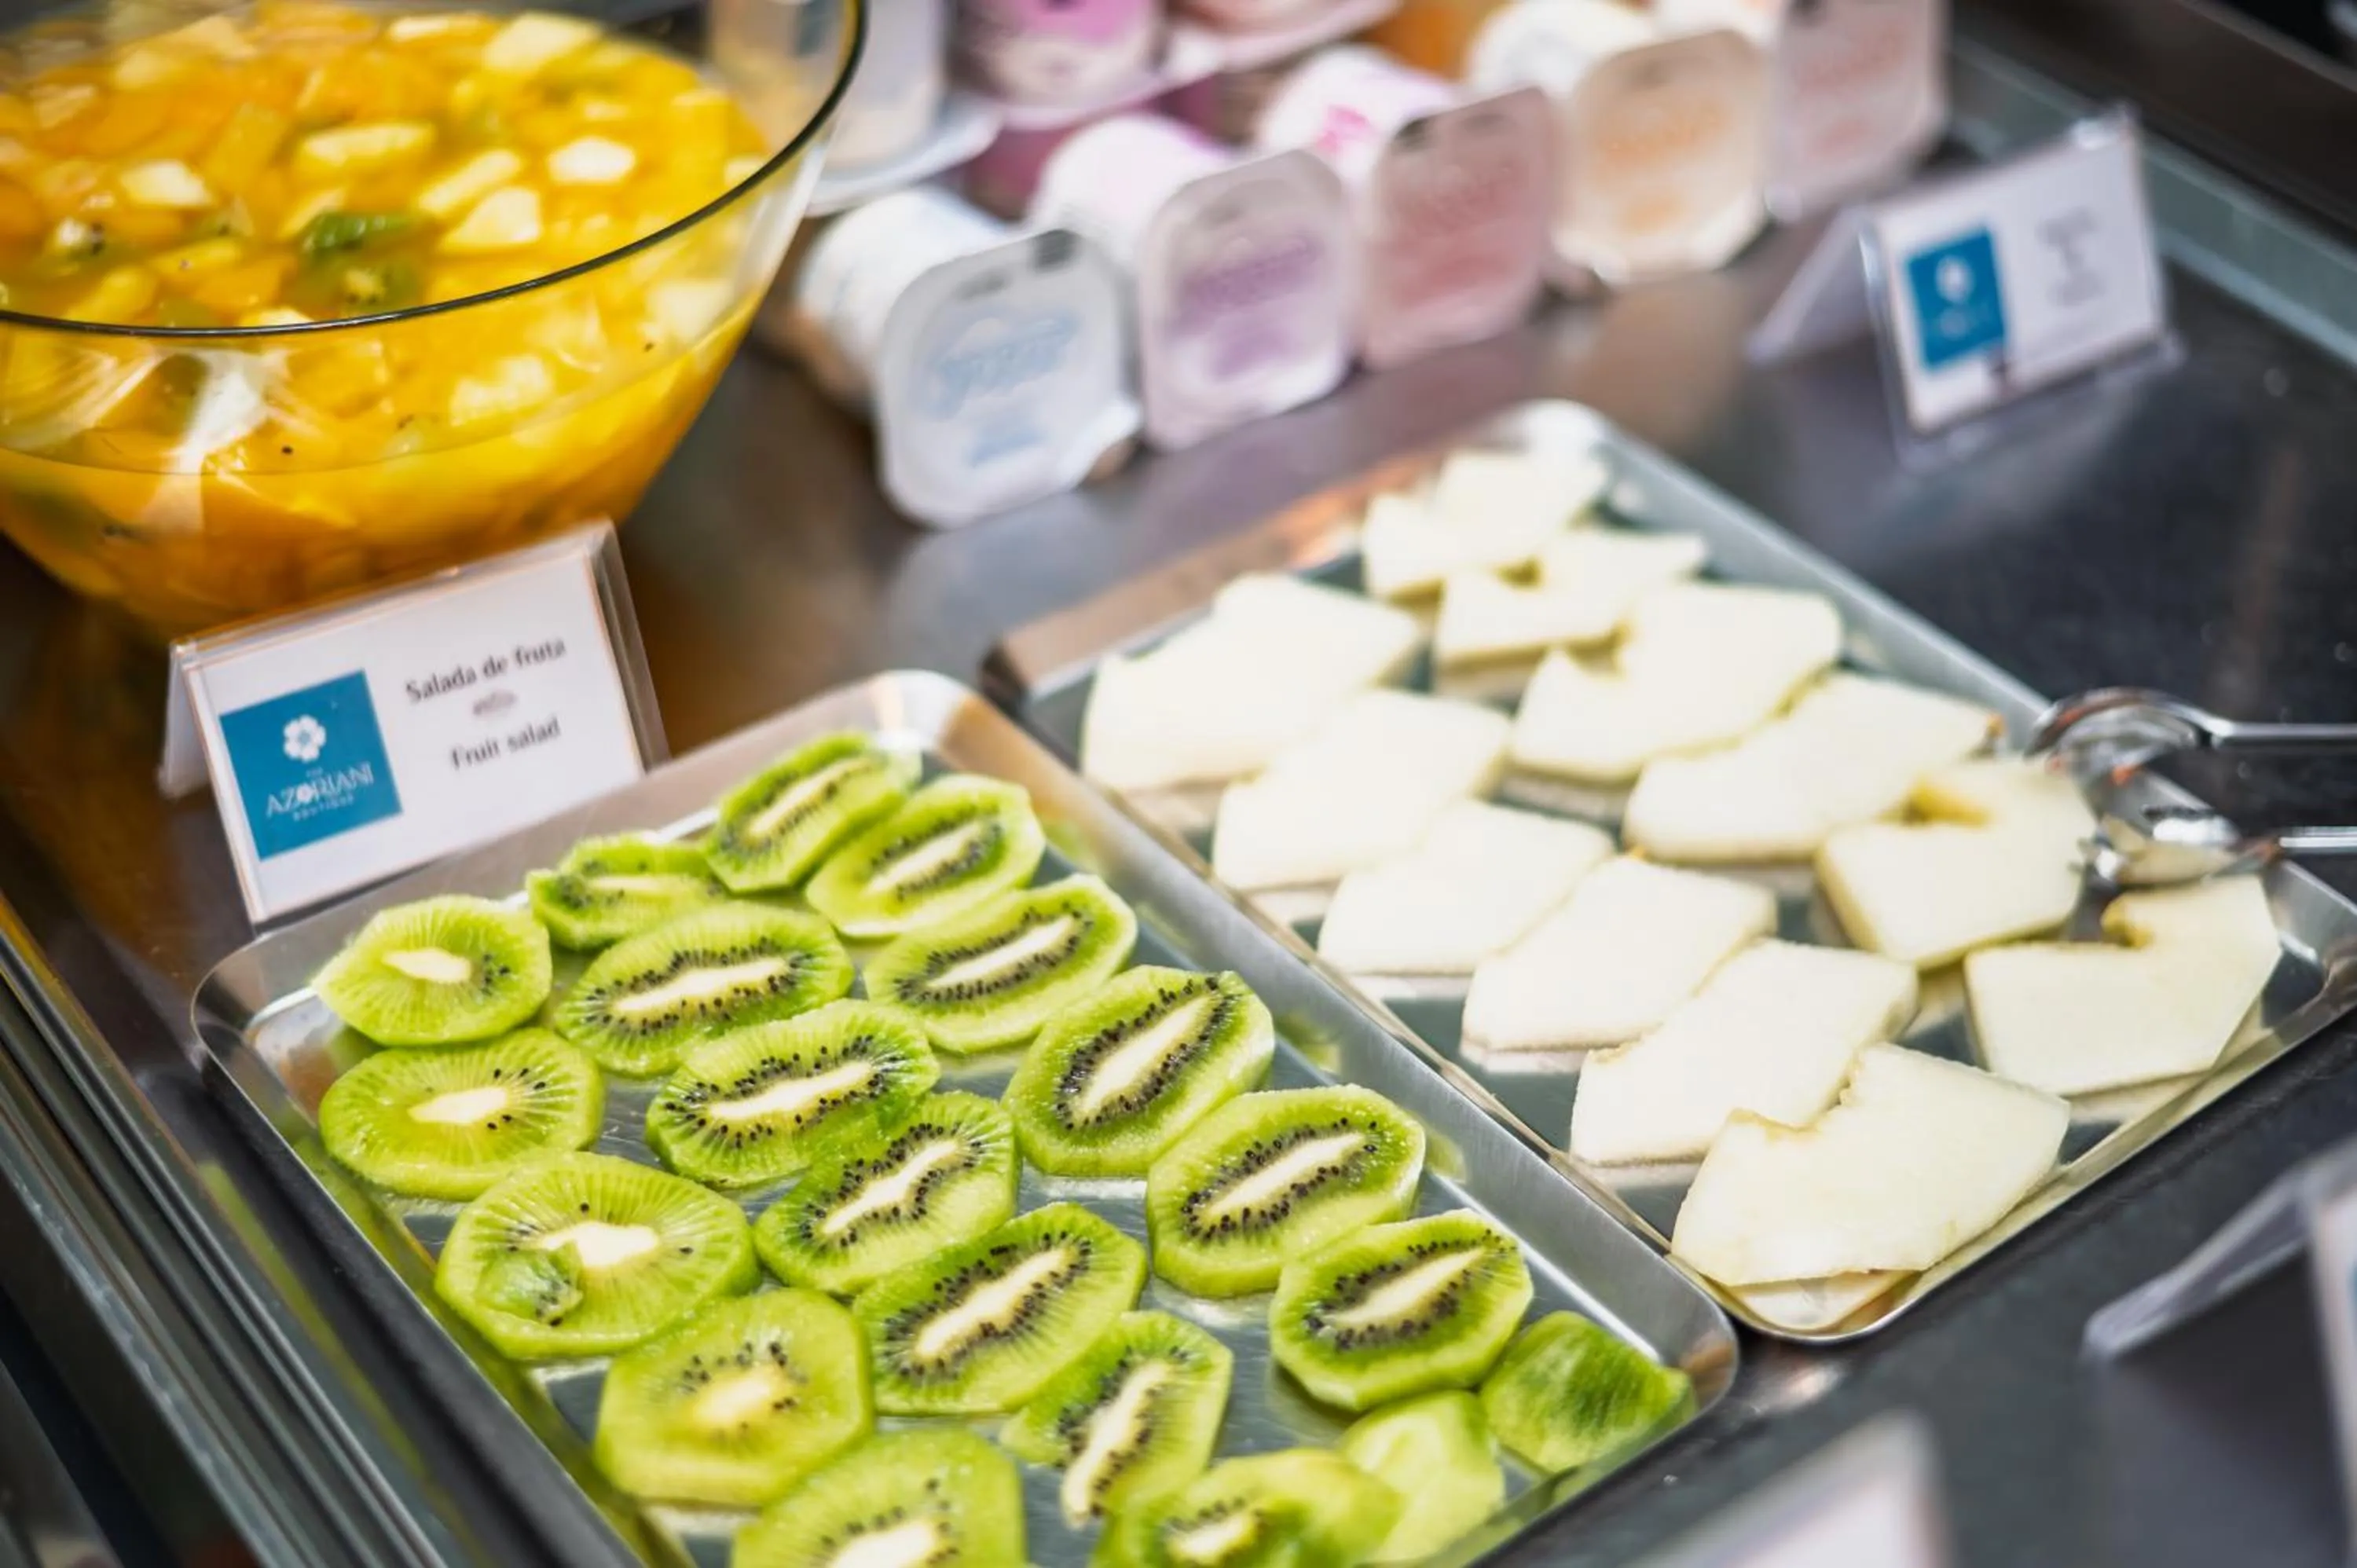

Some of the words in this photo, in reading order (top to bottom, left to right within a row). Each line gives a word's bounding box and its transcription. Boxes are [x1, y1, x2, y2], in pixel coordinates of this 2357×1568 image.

[405, 665, 477, 703] Salada
[482, 655, 509, 678] de
[515, 639, 566, 669] fruta
[450, 738, 500, 771] Fruit
[508, 715, 561, 753] salad
